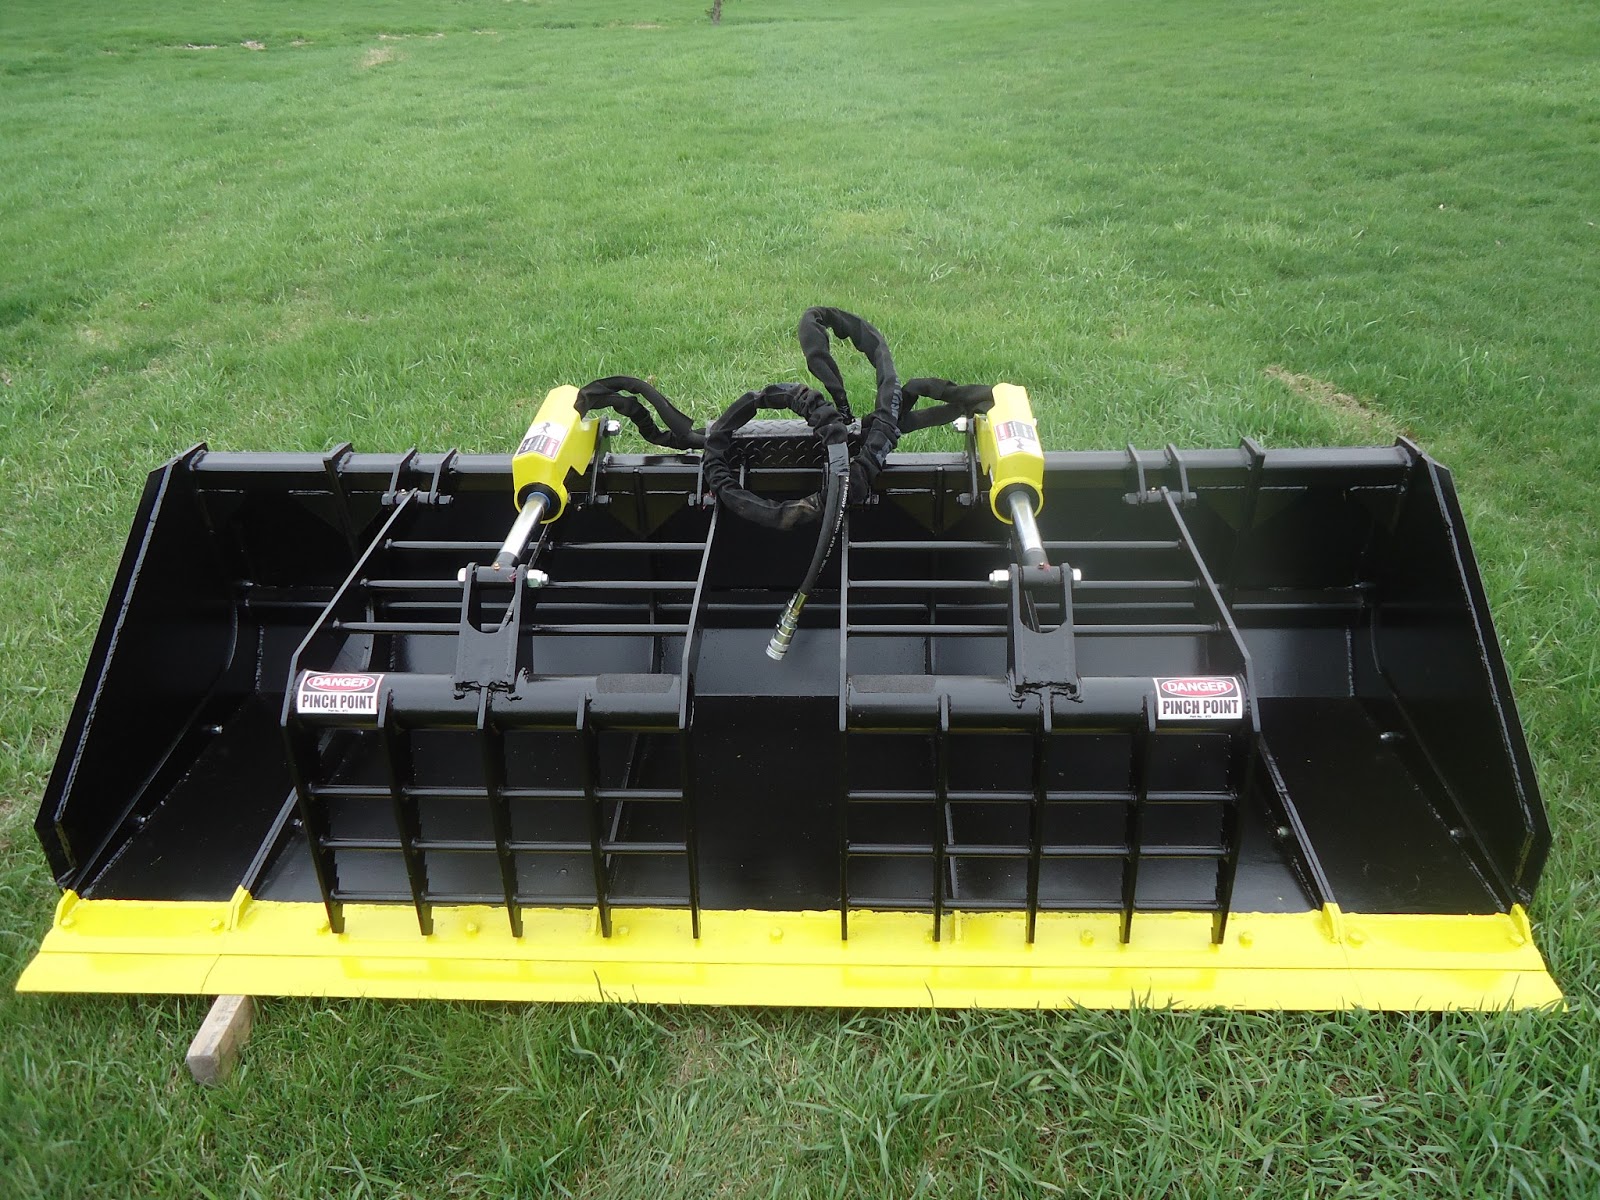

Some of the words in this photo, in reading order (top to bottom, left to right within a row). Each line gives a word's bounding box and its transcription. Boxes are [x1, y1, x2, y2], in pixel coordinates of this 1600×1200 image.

[312, 677, 370, 687] DANGER
[1167, 682, 1228, 692] DANGER
[302, 694, 337, 708] PINCH
[340, 695, 374, 709] POINT
[1163, 700, 1200, 715] PINCH
[1203, 699, 1239, 714] POINT
